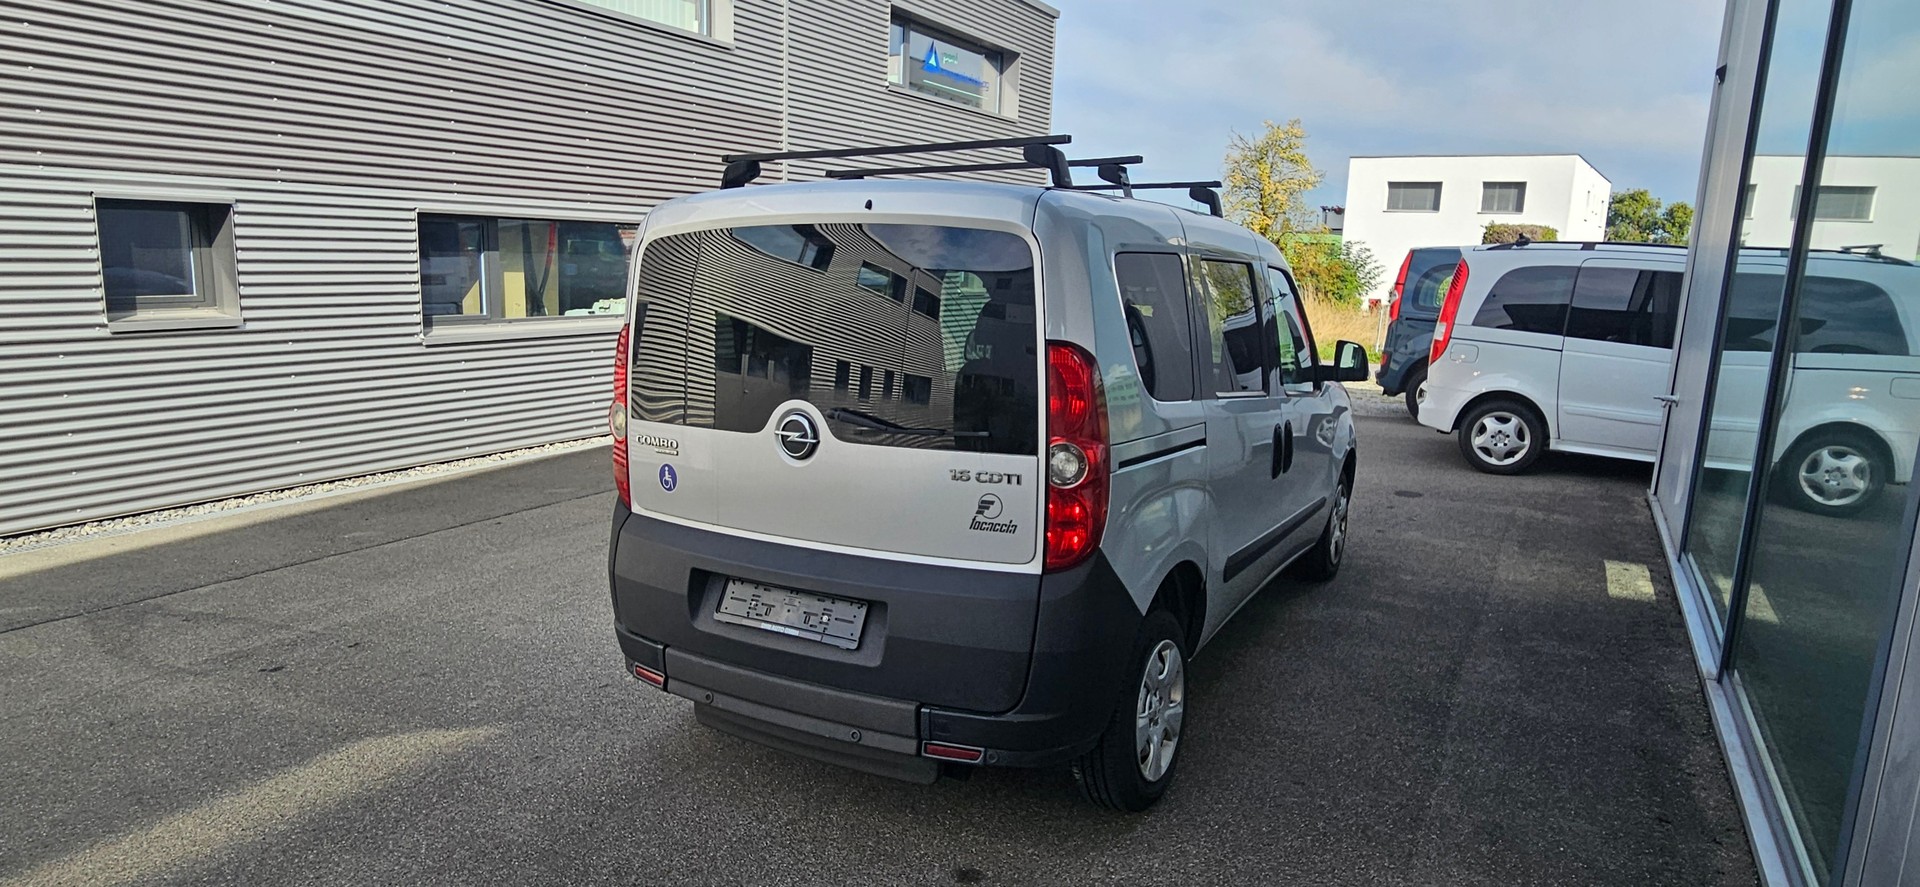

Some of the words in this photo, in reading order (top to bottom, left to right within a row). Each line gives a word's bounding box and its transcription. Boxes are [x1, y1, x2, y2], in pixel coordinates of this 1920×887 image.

[636, 434, 679, 450] COMBO
[975, 471, 1022, 486] CDTI
[969, 515, 1018, 535] focaccia
